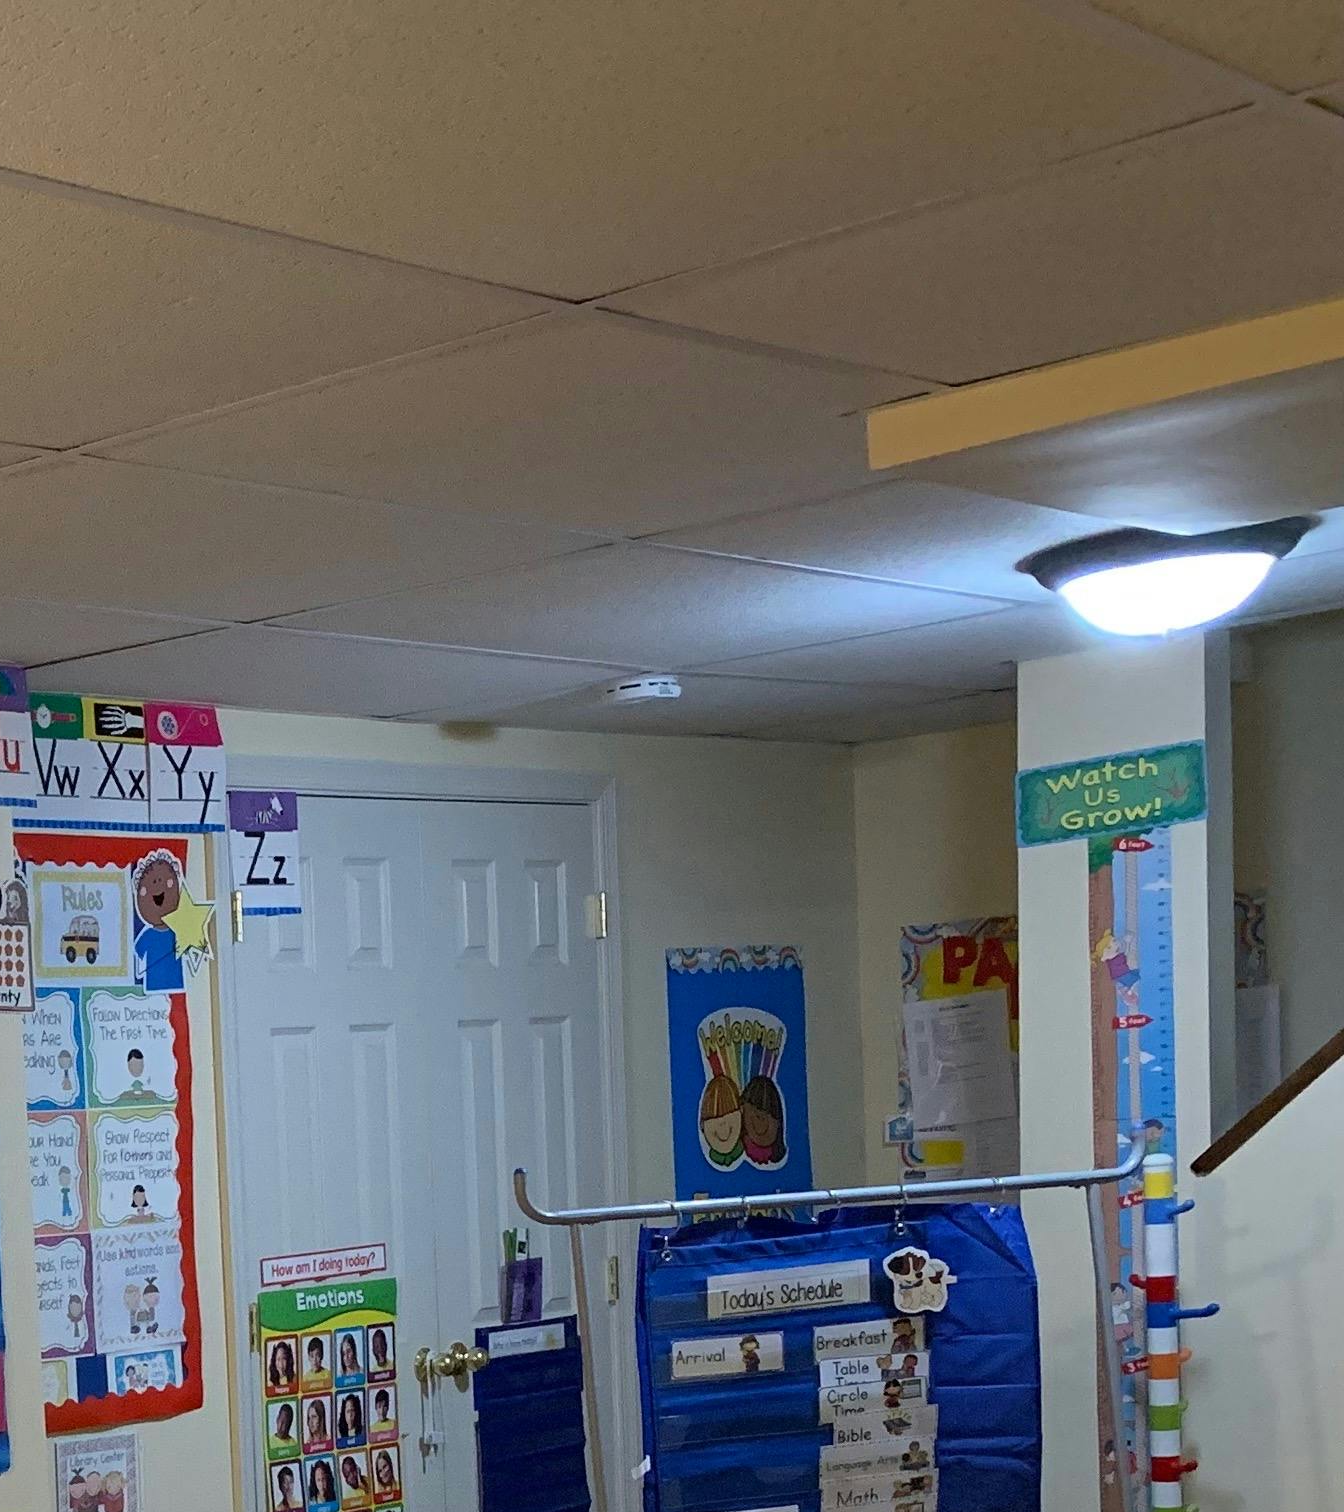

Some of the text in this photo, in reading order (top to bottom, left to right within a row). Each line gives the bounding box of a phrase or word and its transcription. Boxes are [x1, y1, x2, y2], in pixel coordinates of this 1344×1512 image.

[98, 742, 144, 799] Xx
[163, 745, 215, 824] Yy
[1046, 758, 1158, 793] Watch
[1084, 788, 1120, 806] Us
[1061, 798, 1161, 830] Grow!
[245, 831, 287, 885] Zz
[62, 885, 103, 912] Rules
[700, 1013, 783, 1049] Welcome!
[272, 1263, 292, 1277] How
[296, 1262, 310, 1274] am
[319, 1257, 342, 1273] doing
[345, 1253, 376, 1270] today?
[296, 1289, 364, 1311] Emotions
[721, 1280, 842, 1310] Today's Schedule
[816, 1330, 888, 1350] Breakfast
[676, 1349, 725, 1364] Arrival
[827, 1390, 868, 1404] Circle
[838, 1430, 872, 1443] Bible
